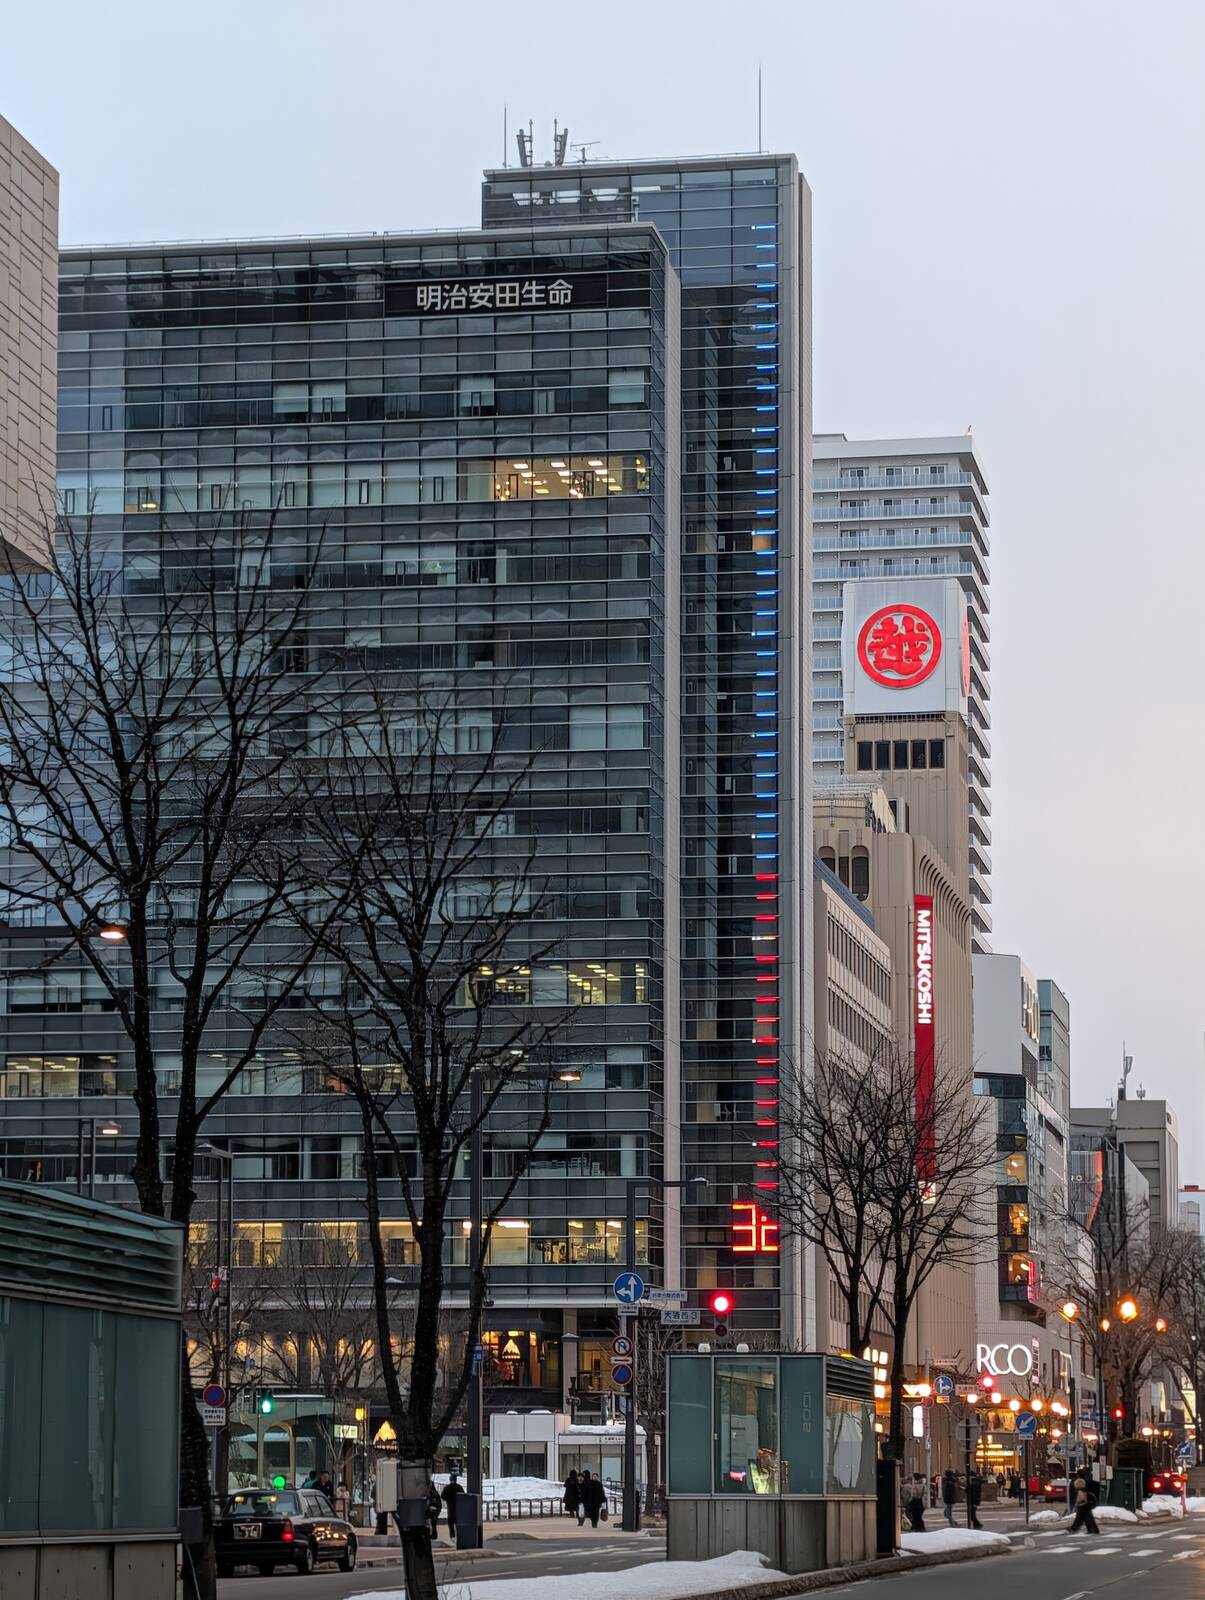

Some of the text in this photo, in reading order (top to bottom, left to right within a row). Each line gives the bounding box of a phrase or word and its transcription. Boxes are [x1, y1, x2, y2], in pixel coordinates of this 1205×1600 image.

[416, 279, 573, 311] 明治安田生命
[917, 909, 932, 1024] MITSUKOSHI
